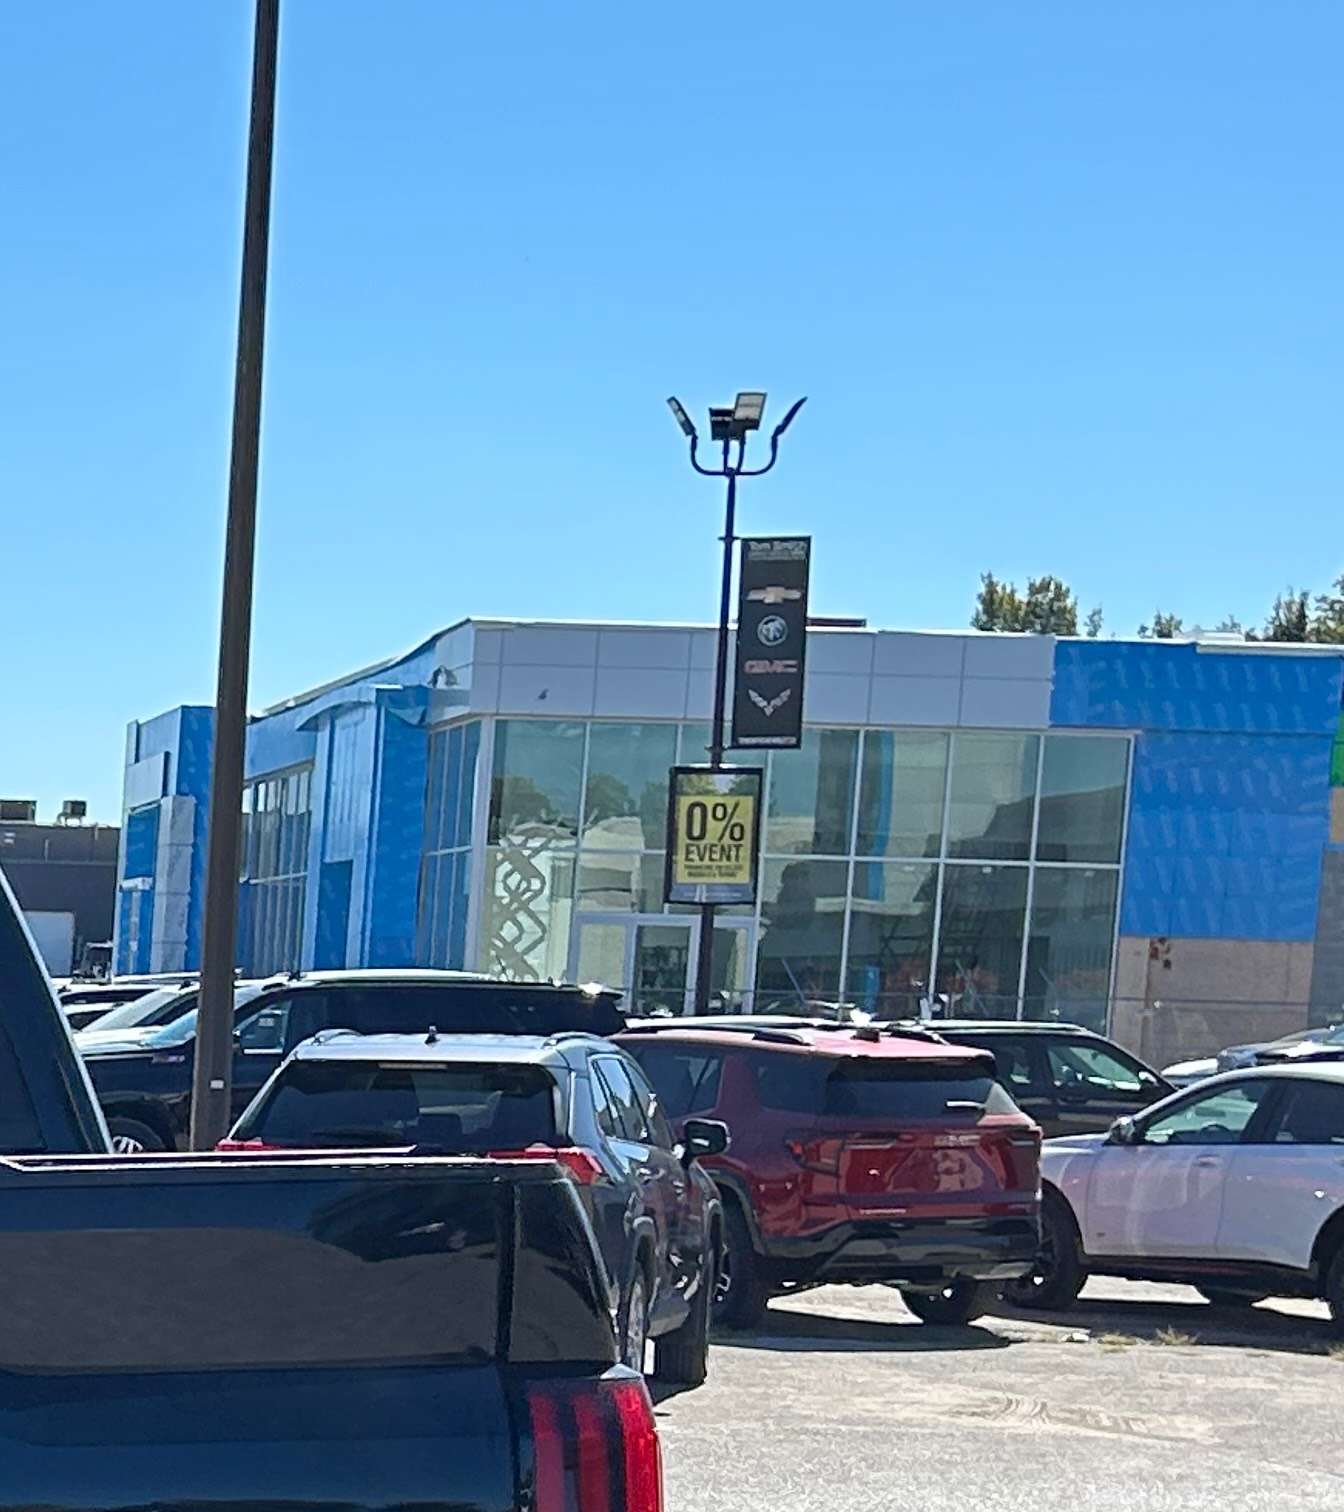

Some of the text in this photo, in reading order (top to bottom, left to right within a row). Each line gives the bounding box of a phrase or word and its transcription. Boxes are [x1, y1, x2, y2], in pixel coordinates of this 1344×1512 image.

[744, 660, 798, 674] GMC
[685, 800, 745, 843] 0%
[684, 842, 744, 863] EVENT
